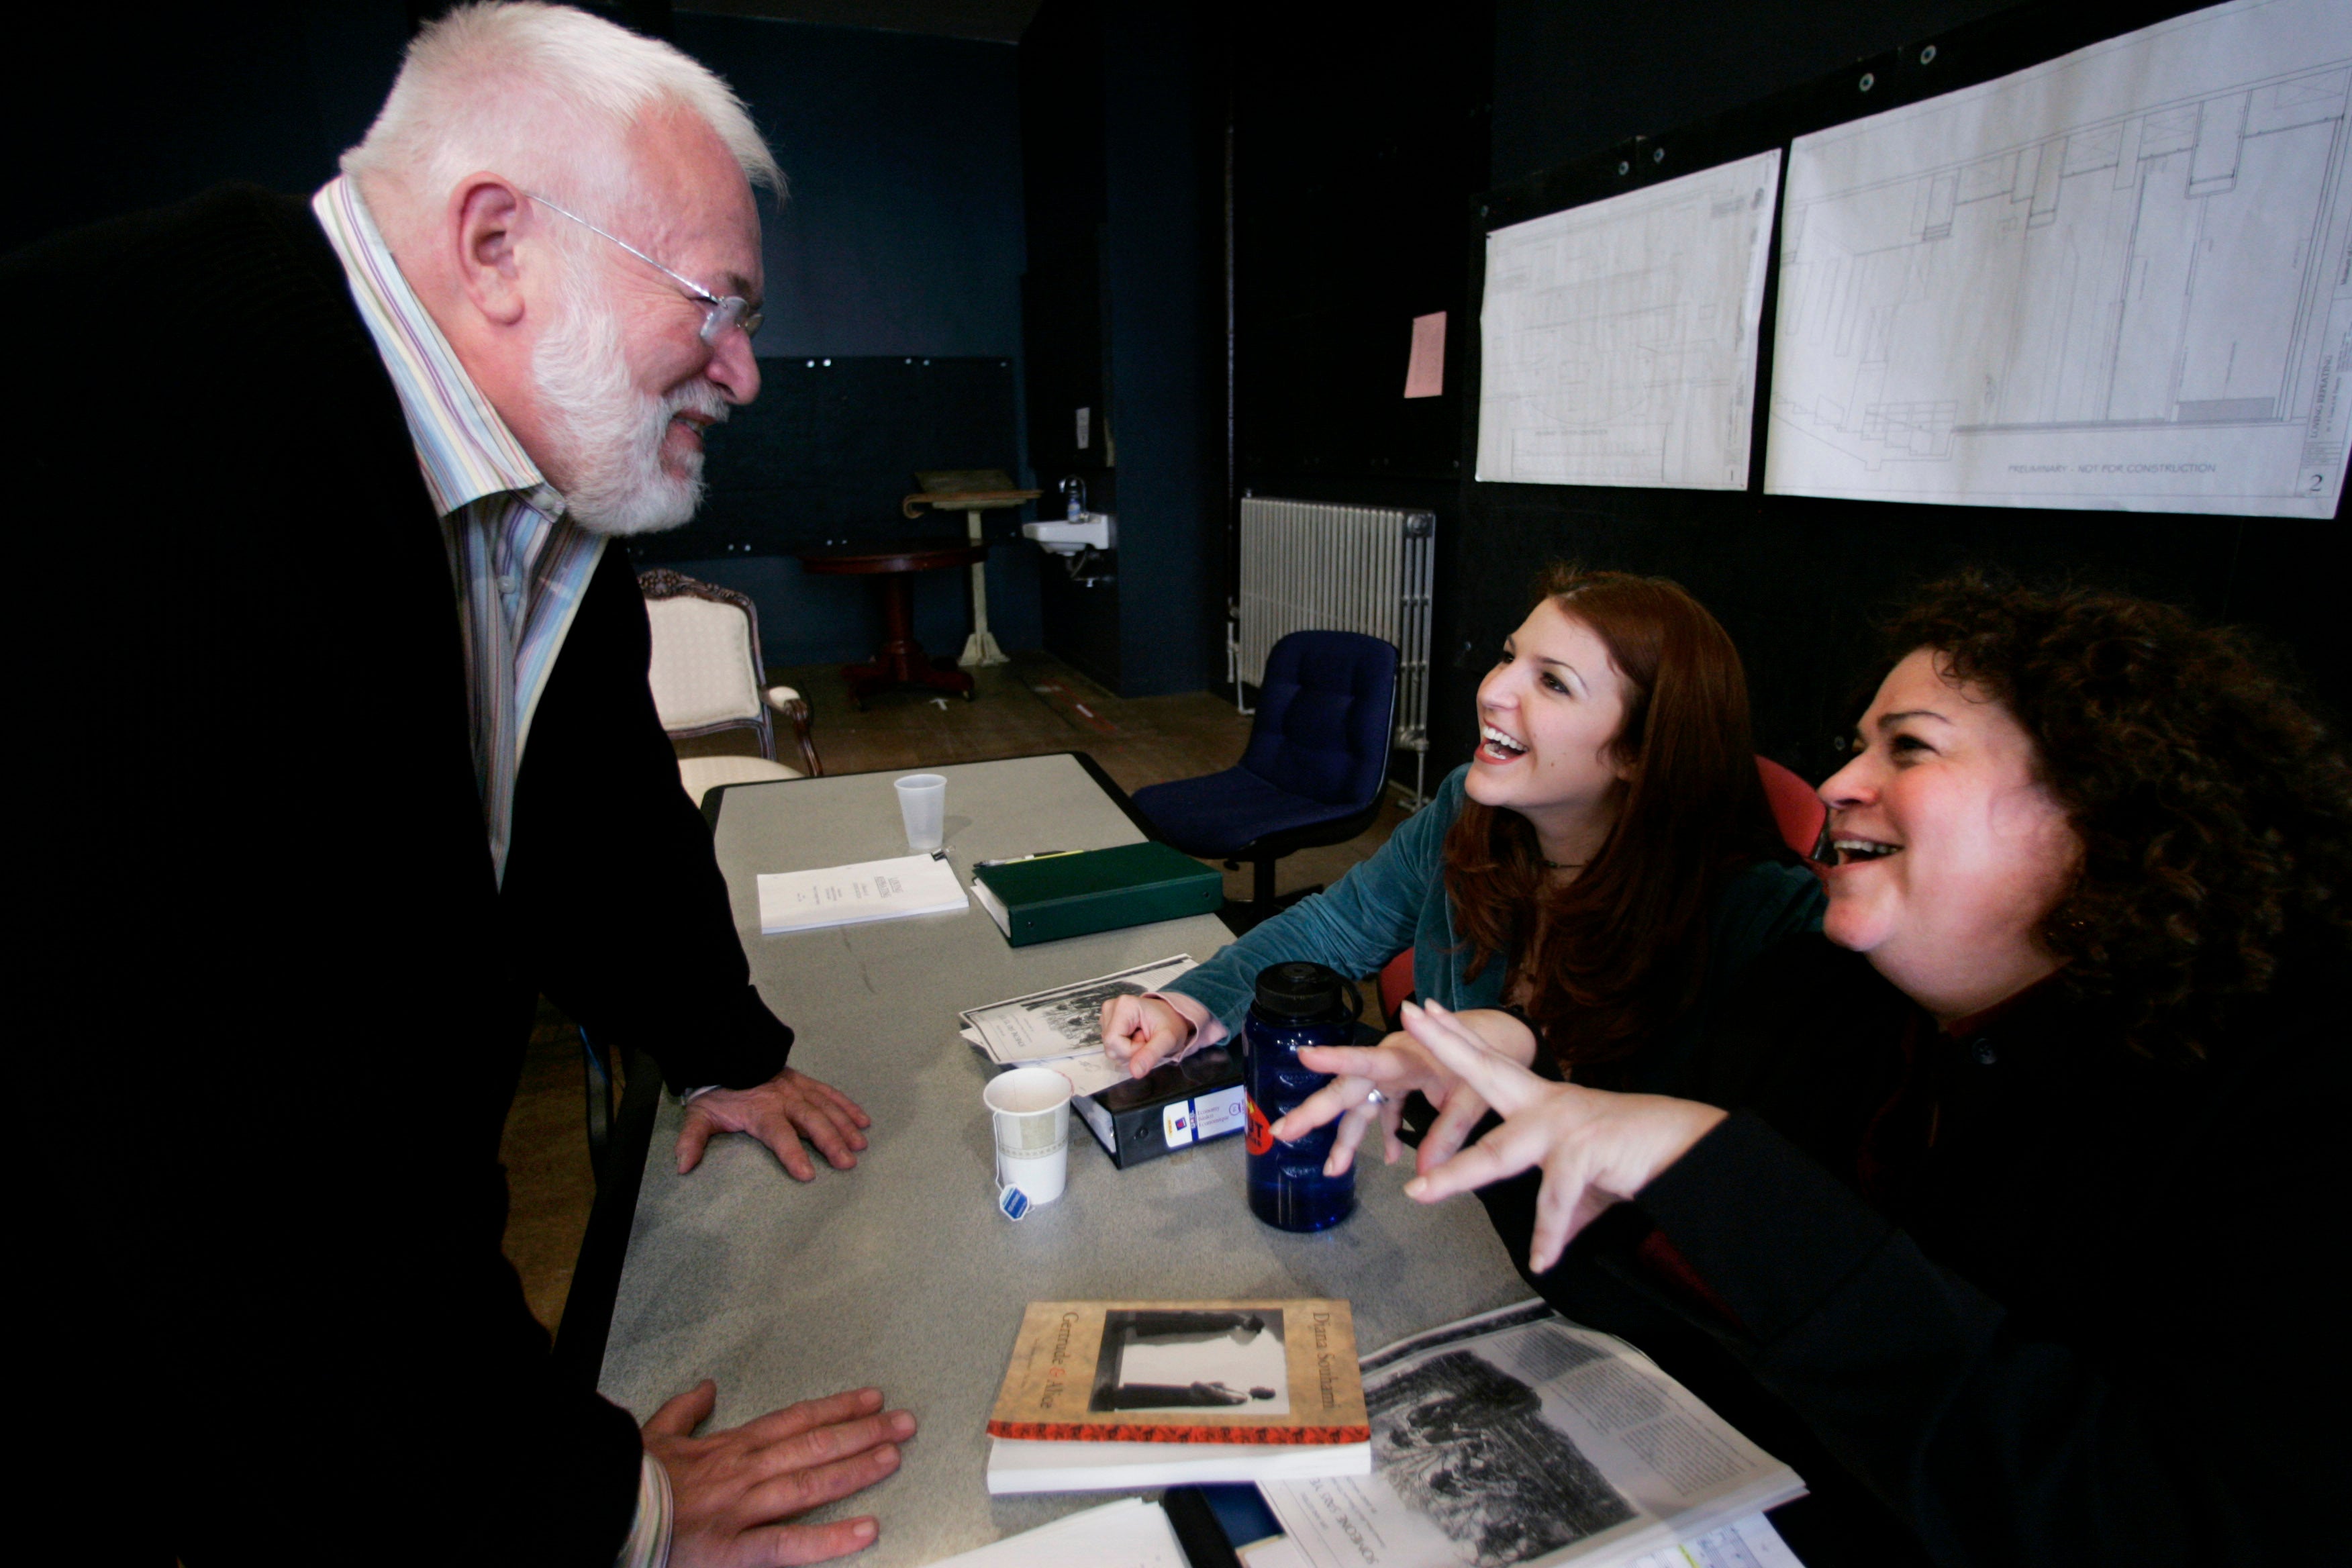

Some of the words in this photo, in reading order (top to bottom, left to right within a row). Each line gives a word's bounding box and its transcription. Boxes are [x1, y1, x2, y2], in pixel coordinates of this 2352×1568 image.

[2008, 464, 2067, 474] PRELIMINARY
[2078, 464, 2096, 474] NOT
[2101, 464, 2123, 474] FOR
[2126, 463, 2216, 474] CONSTRUCTION
[2310, 474, 2323, 491] 2
[1052, 1312, 1079, 1364] Gertrude
[1313, 1312, 1332, 1349] Diana
[1049, 1367, 1066, 1377] &
[1317, 1353, 1342, 1409] Souhami
[1040, 1379, 1063, 1409] Alice
[1336, 1514, 1379, 1565] SOMEONE
